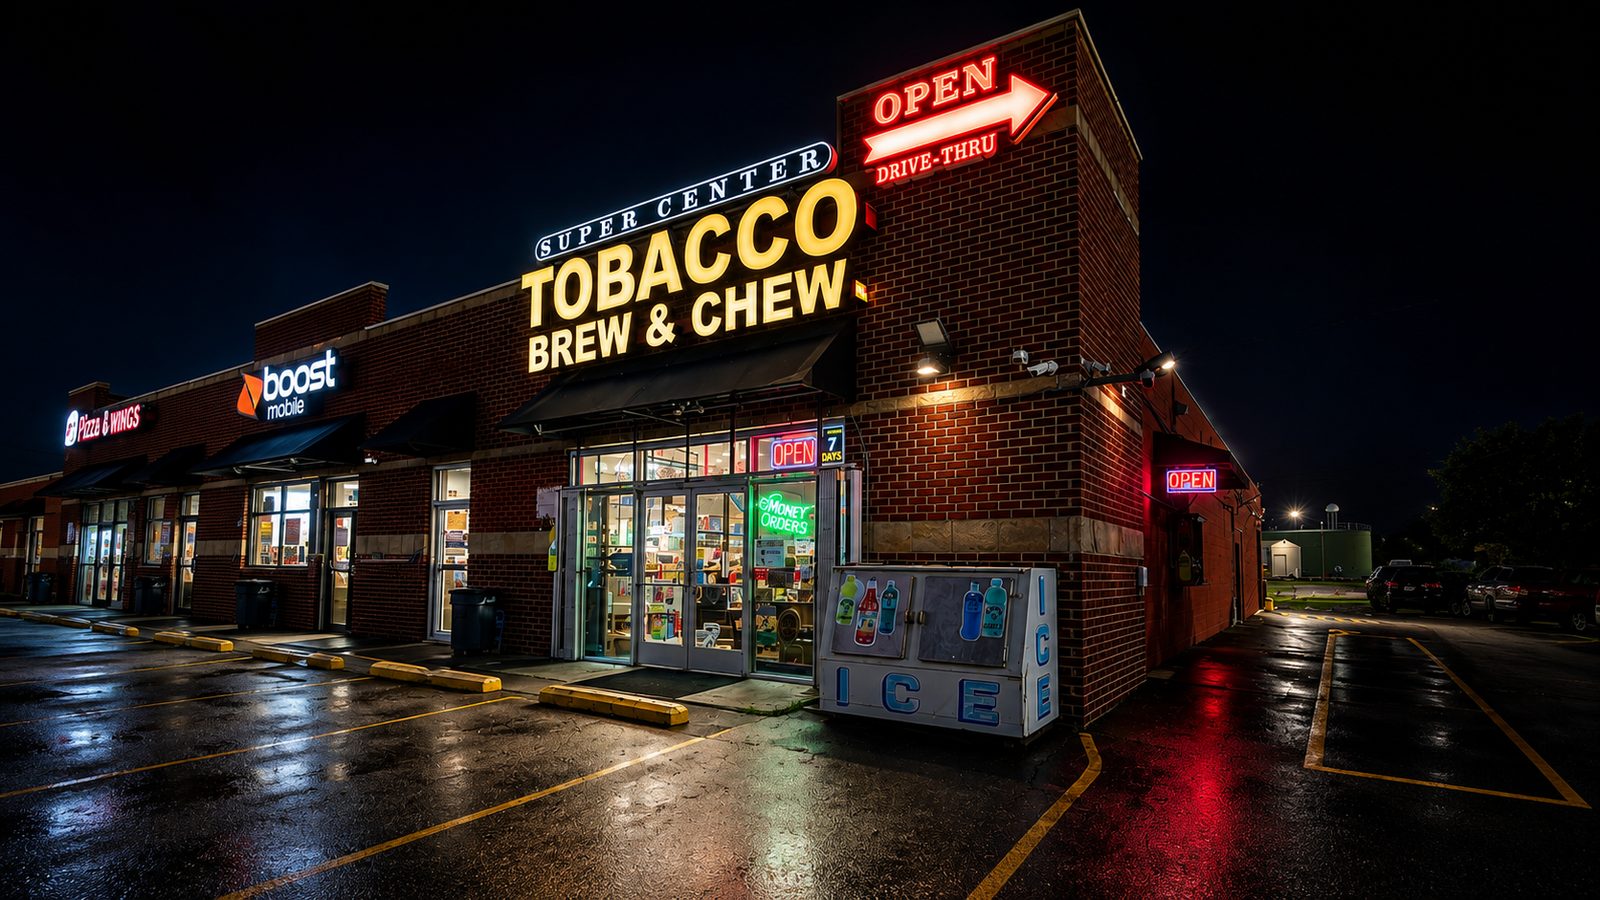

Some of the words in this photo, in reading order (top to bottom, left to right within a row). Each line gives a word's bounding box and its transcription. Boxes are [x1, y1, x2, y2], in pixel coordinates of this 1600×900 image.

[874, 57, 995, 125] OPEN
[876, 133, 996, 184] DRIVE-THRU
[540, 210, 637, 257] SUPER
[657, 148, 821, 218] CENTER
[521, 178, 857, 328] TOBACCO
[528, 312, 632, 373] BREW
[645, 303, 675, 347] &
[691, 259, 847, 337] CHEW
[263, 349, 336, 401] boost
[102, 410, 110, 436] &
[110, 404, 141, 434] WINGS
[267, 396, 304, 420] mobile
[773, 440, 815, 466] OPEN
[822, 451, 842, 462] DAYS
[828, 436, 837, 451] 7
[1169, 471, 1214, 488] OPEN
[761, 512, 808, 535] ORDERS
[767, 499, 810, 519] MONEY
[1036, 575, 1051, 720] ICE
[836, 666, 1000, 727] ICE
